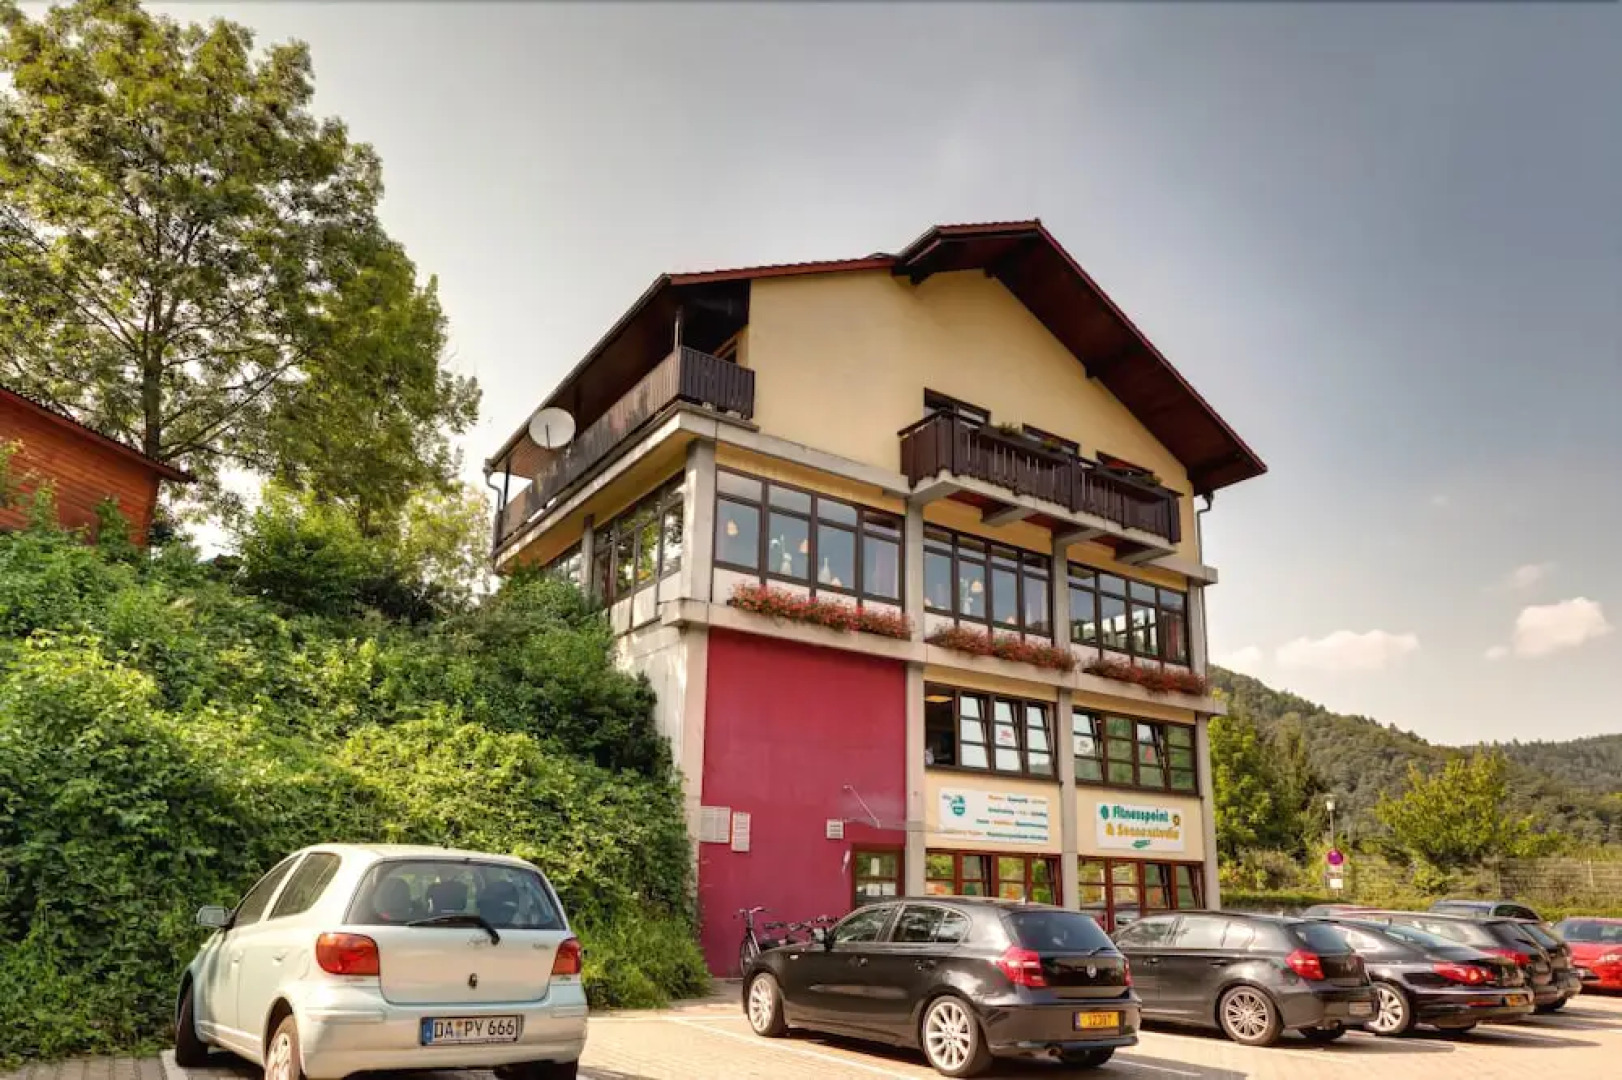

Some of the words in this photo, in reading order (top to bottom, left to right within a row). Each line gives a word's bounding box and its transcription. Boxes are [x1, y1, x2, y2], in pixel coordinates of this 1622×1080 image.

[1113, 805, 1168, 824] Fitnesspoint
[434, 1021, 453, 1038] DA
[464, 1020, 483, 1037] PY
[488, 1019, 515, 1035] 666
